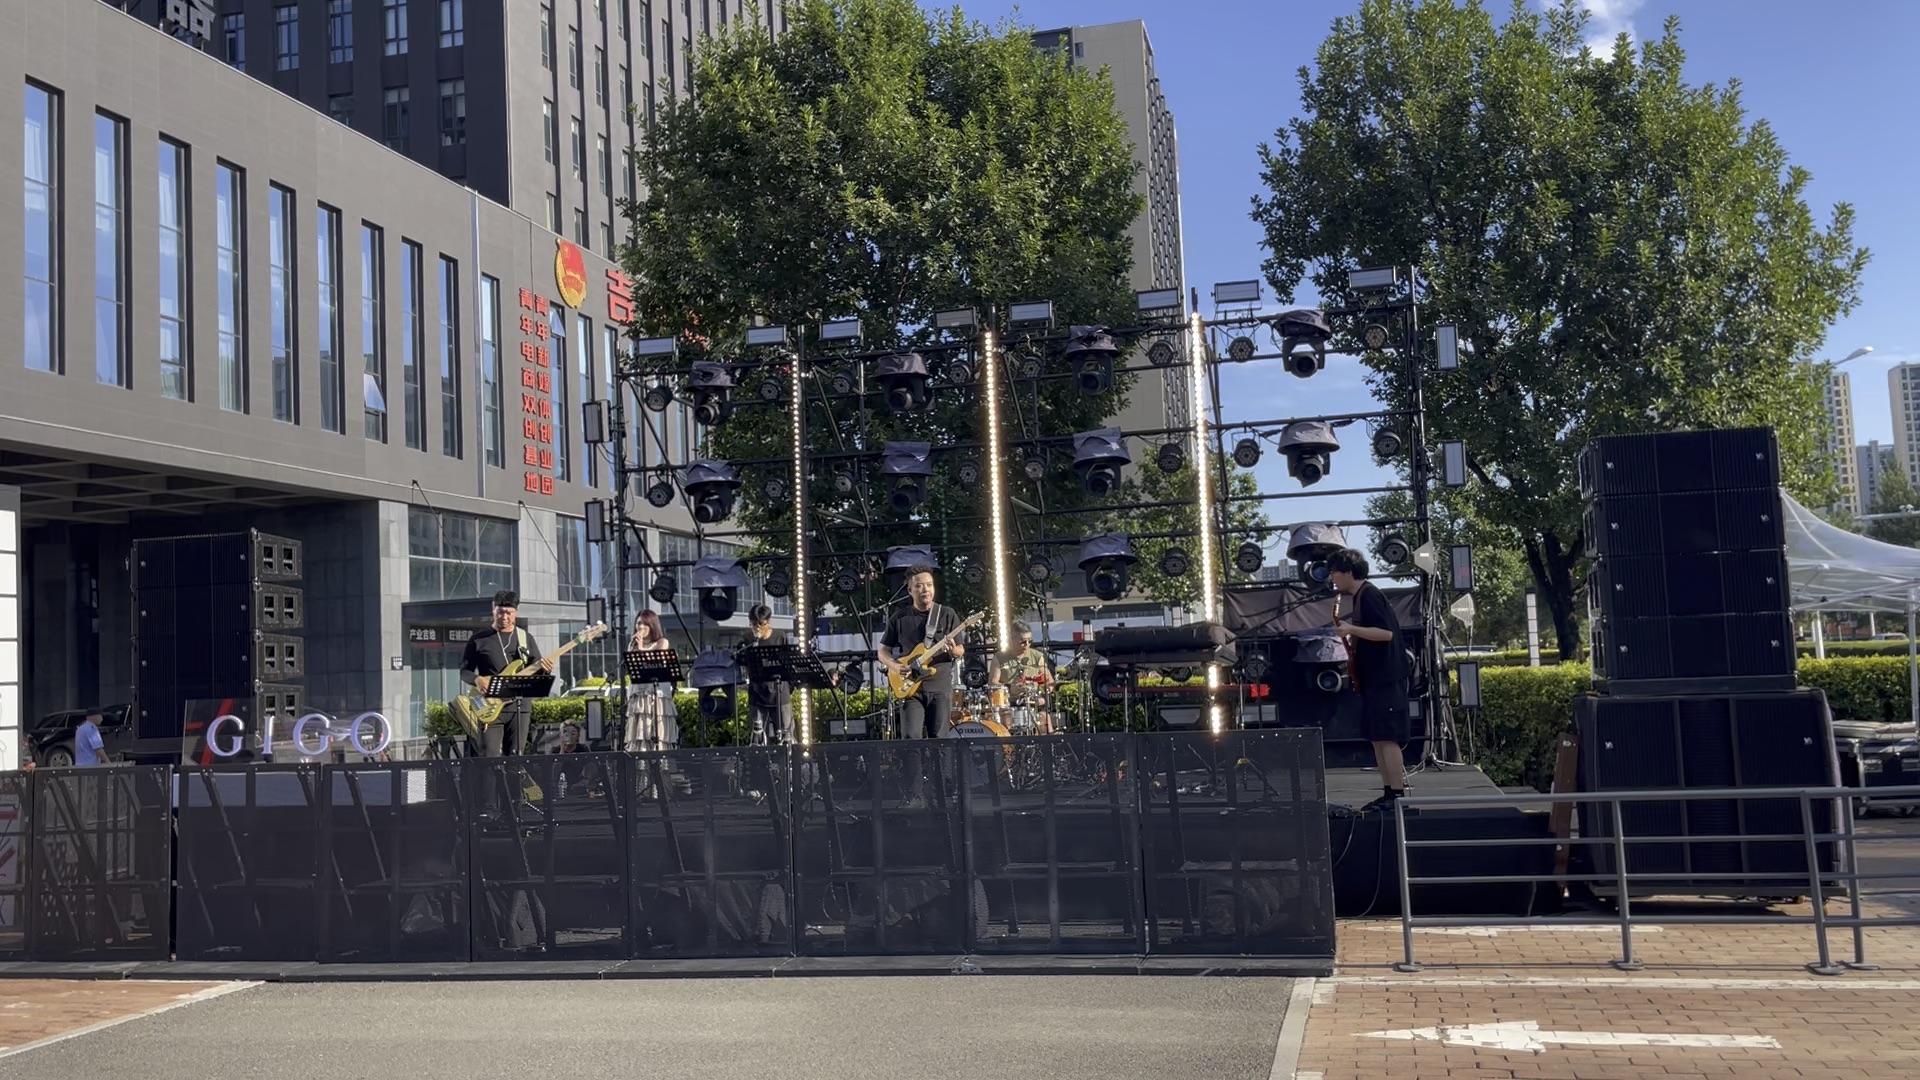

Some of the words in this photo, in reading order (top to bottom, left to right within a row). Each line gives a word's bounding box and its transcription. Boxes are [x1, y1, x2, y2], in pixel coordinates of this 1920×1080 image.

[519, 287, 538, 492] 青年电商双创基地
[535, 294, 554, 495] 青年新媒体创业园
[207, 711, 391, 757] GIGO
